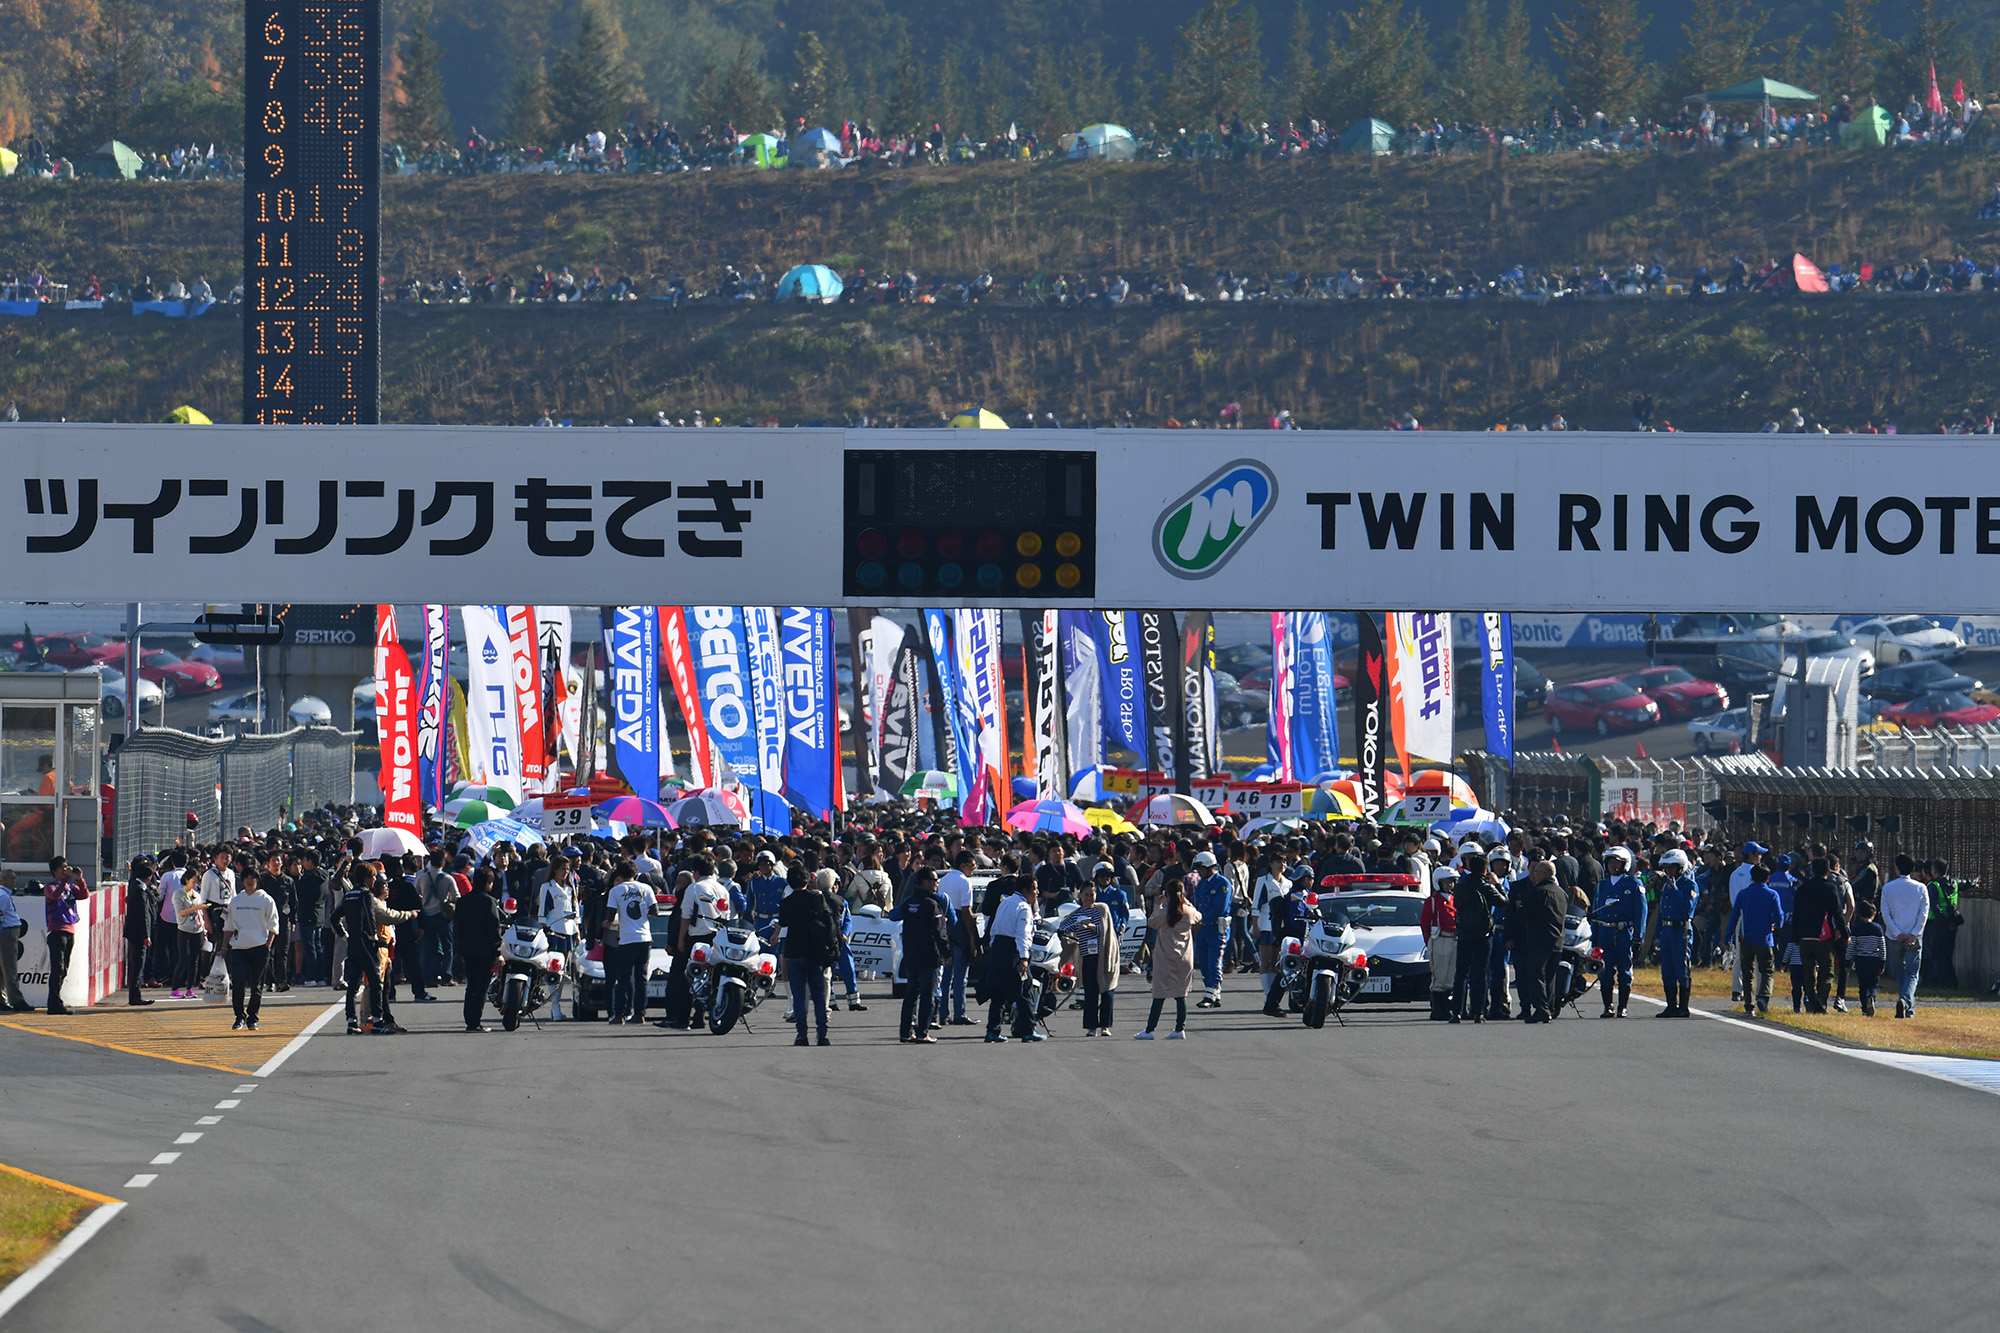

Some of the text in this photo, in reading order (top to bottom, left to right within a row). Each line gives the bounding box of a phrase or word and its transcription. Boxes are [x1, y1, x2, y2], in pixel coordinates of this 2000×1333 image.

[264, 9, 364, 46] 6 36
[263, 52, 364, 90] 7 38
[262, 96, 364, 135] 8 46
[263, 141, 358, 179] 9 1
[256, 184, 364, 223] 10 17
[256, 229, 364, 267] 11 8
[256, 273, 364, 311] 12 24
[256, 317, 364, 355] 13 15
[256, 361, 358, 399] 14 1
[1307, 493, 1515, 551] TWIN
[1559, 493, 1760, 554] RING
[295, 629, 356, 644] SEIKO
[1200, 788, 1215, 802] 17
[1236, 791, 1260, 805] 46
[1270, 794, 1292, 809] 19
[1414, 797, 1441, 812] 37
[554, 809, 582, 826] 39
[851, 932, 892, 945] CAR
[864, 957, 883, 965] GT
